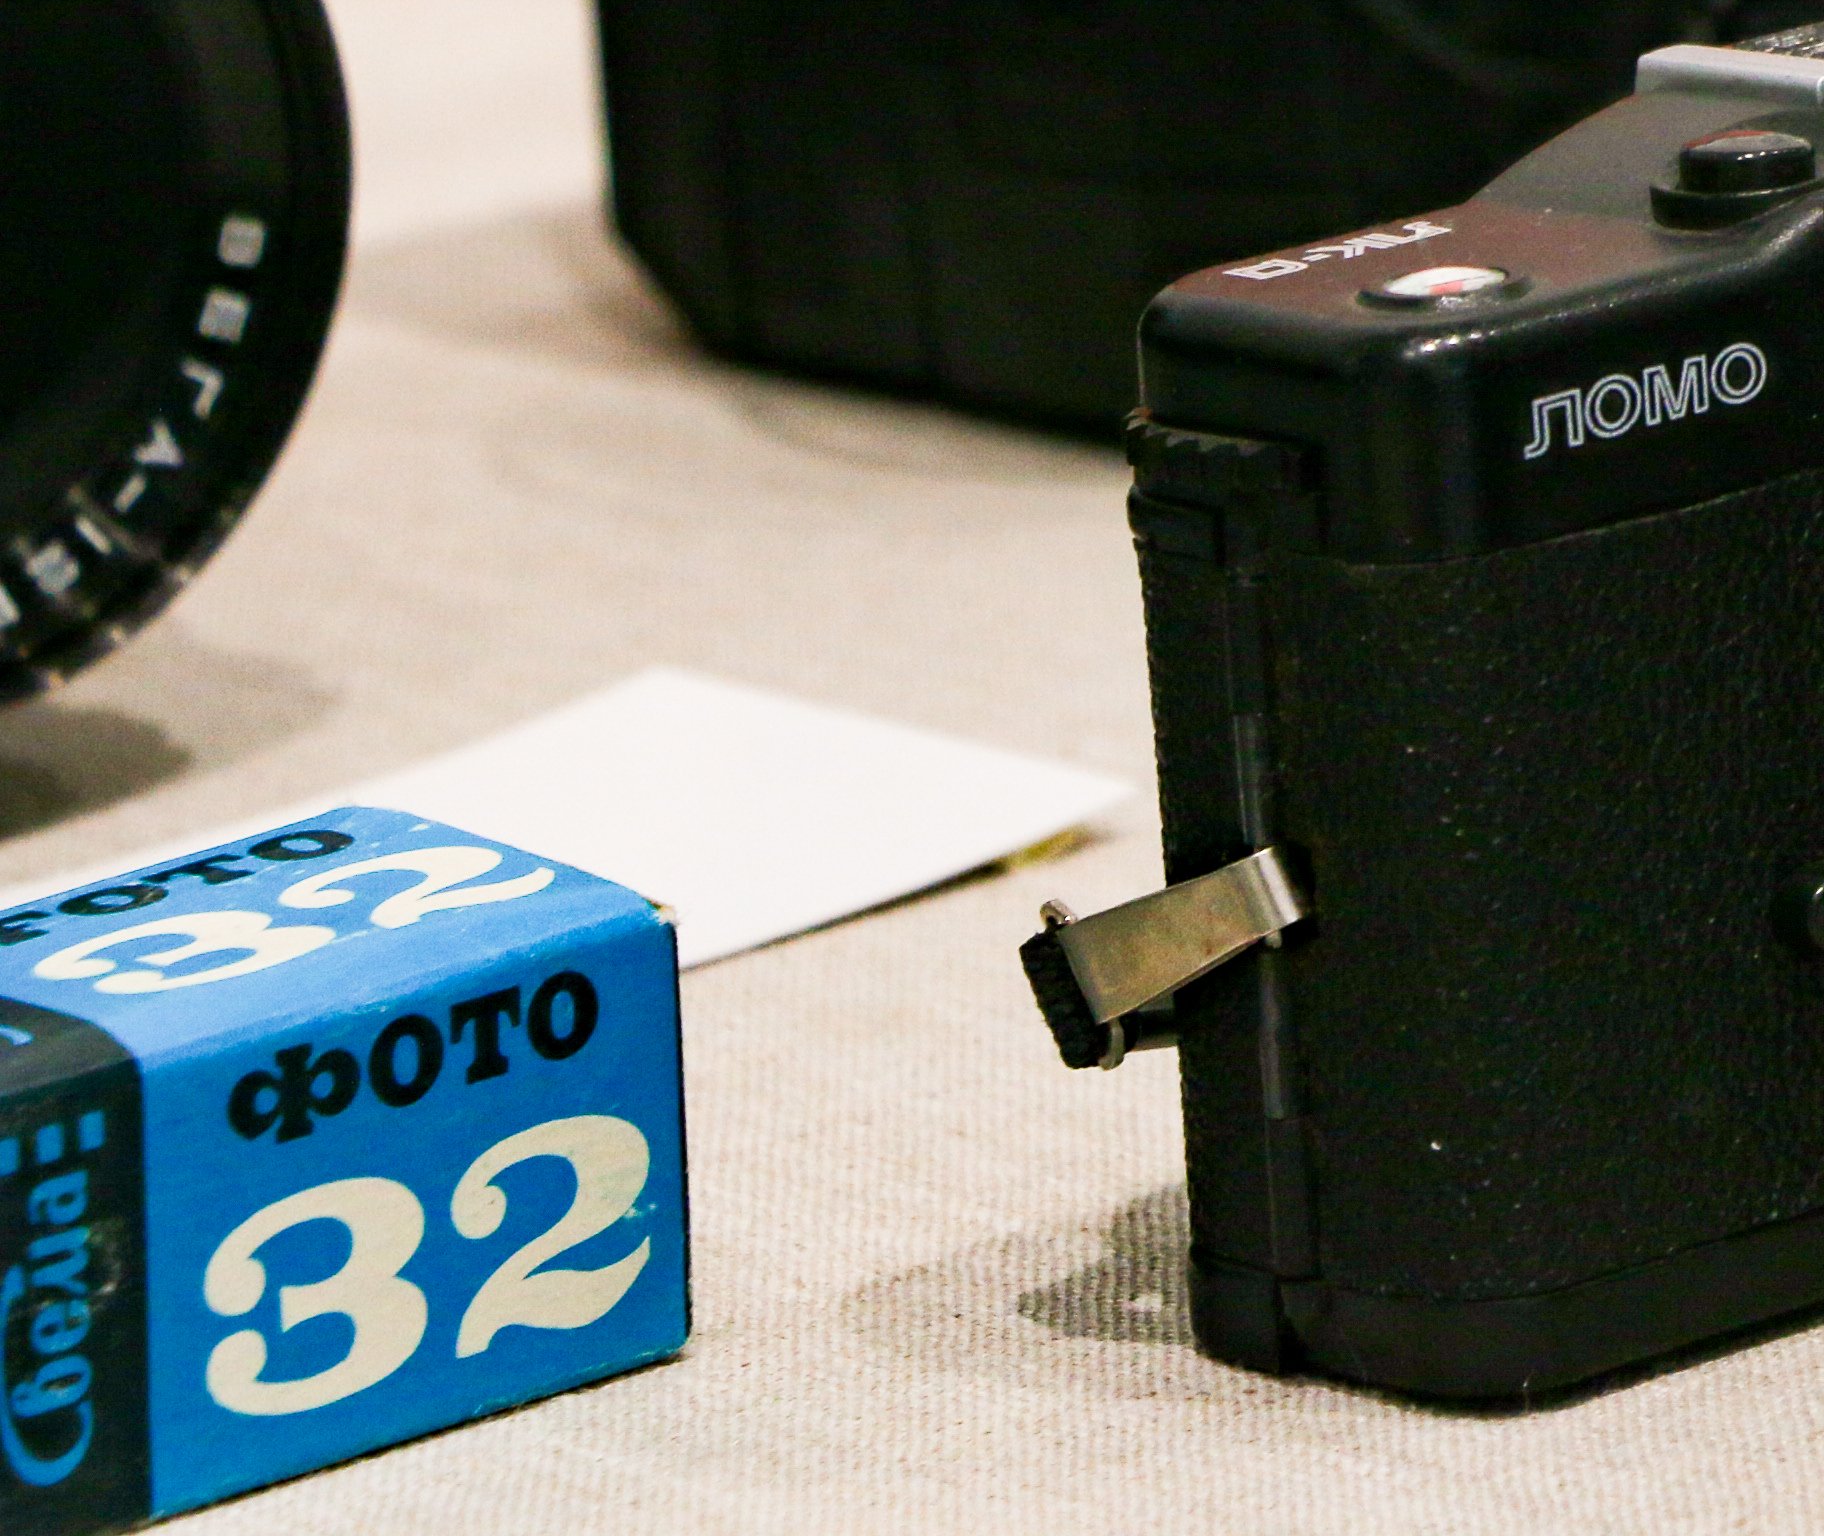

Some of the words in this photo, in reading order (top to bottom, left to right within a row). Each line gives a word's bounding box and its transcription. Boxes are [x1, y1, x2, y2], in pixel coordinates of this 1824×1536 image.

[1524, 343, 1768, 460] ЛОМО
[33, 844, 555, 995] 32
[227, 970, 599, 1144] ФОТО
[203, 1113, 651, 1417] 32
